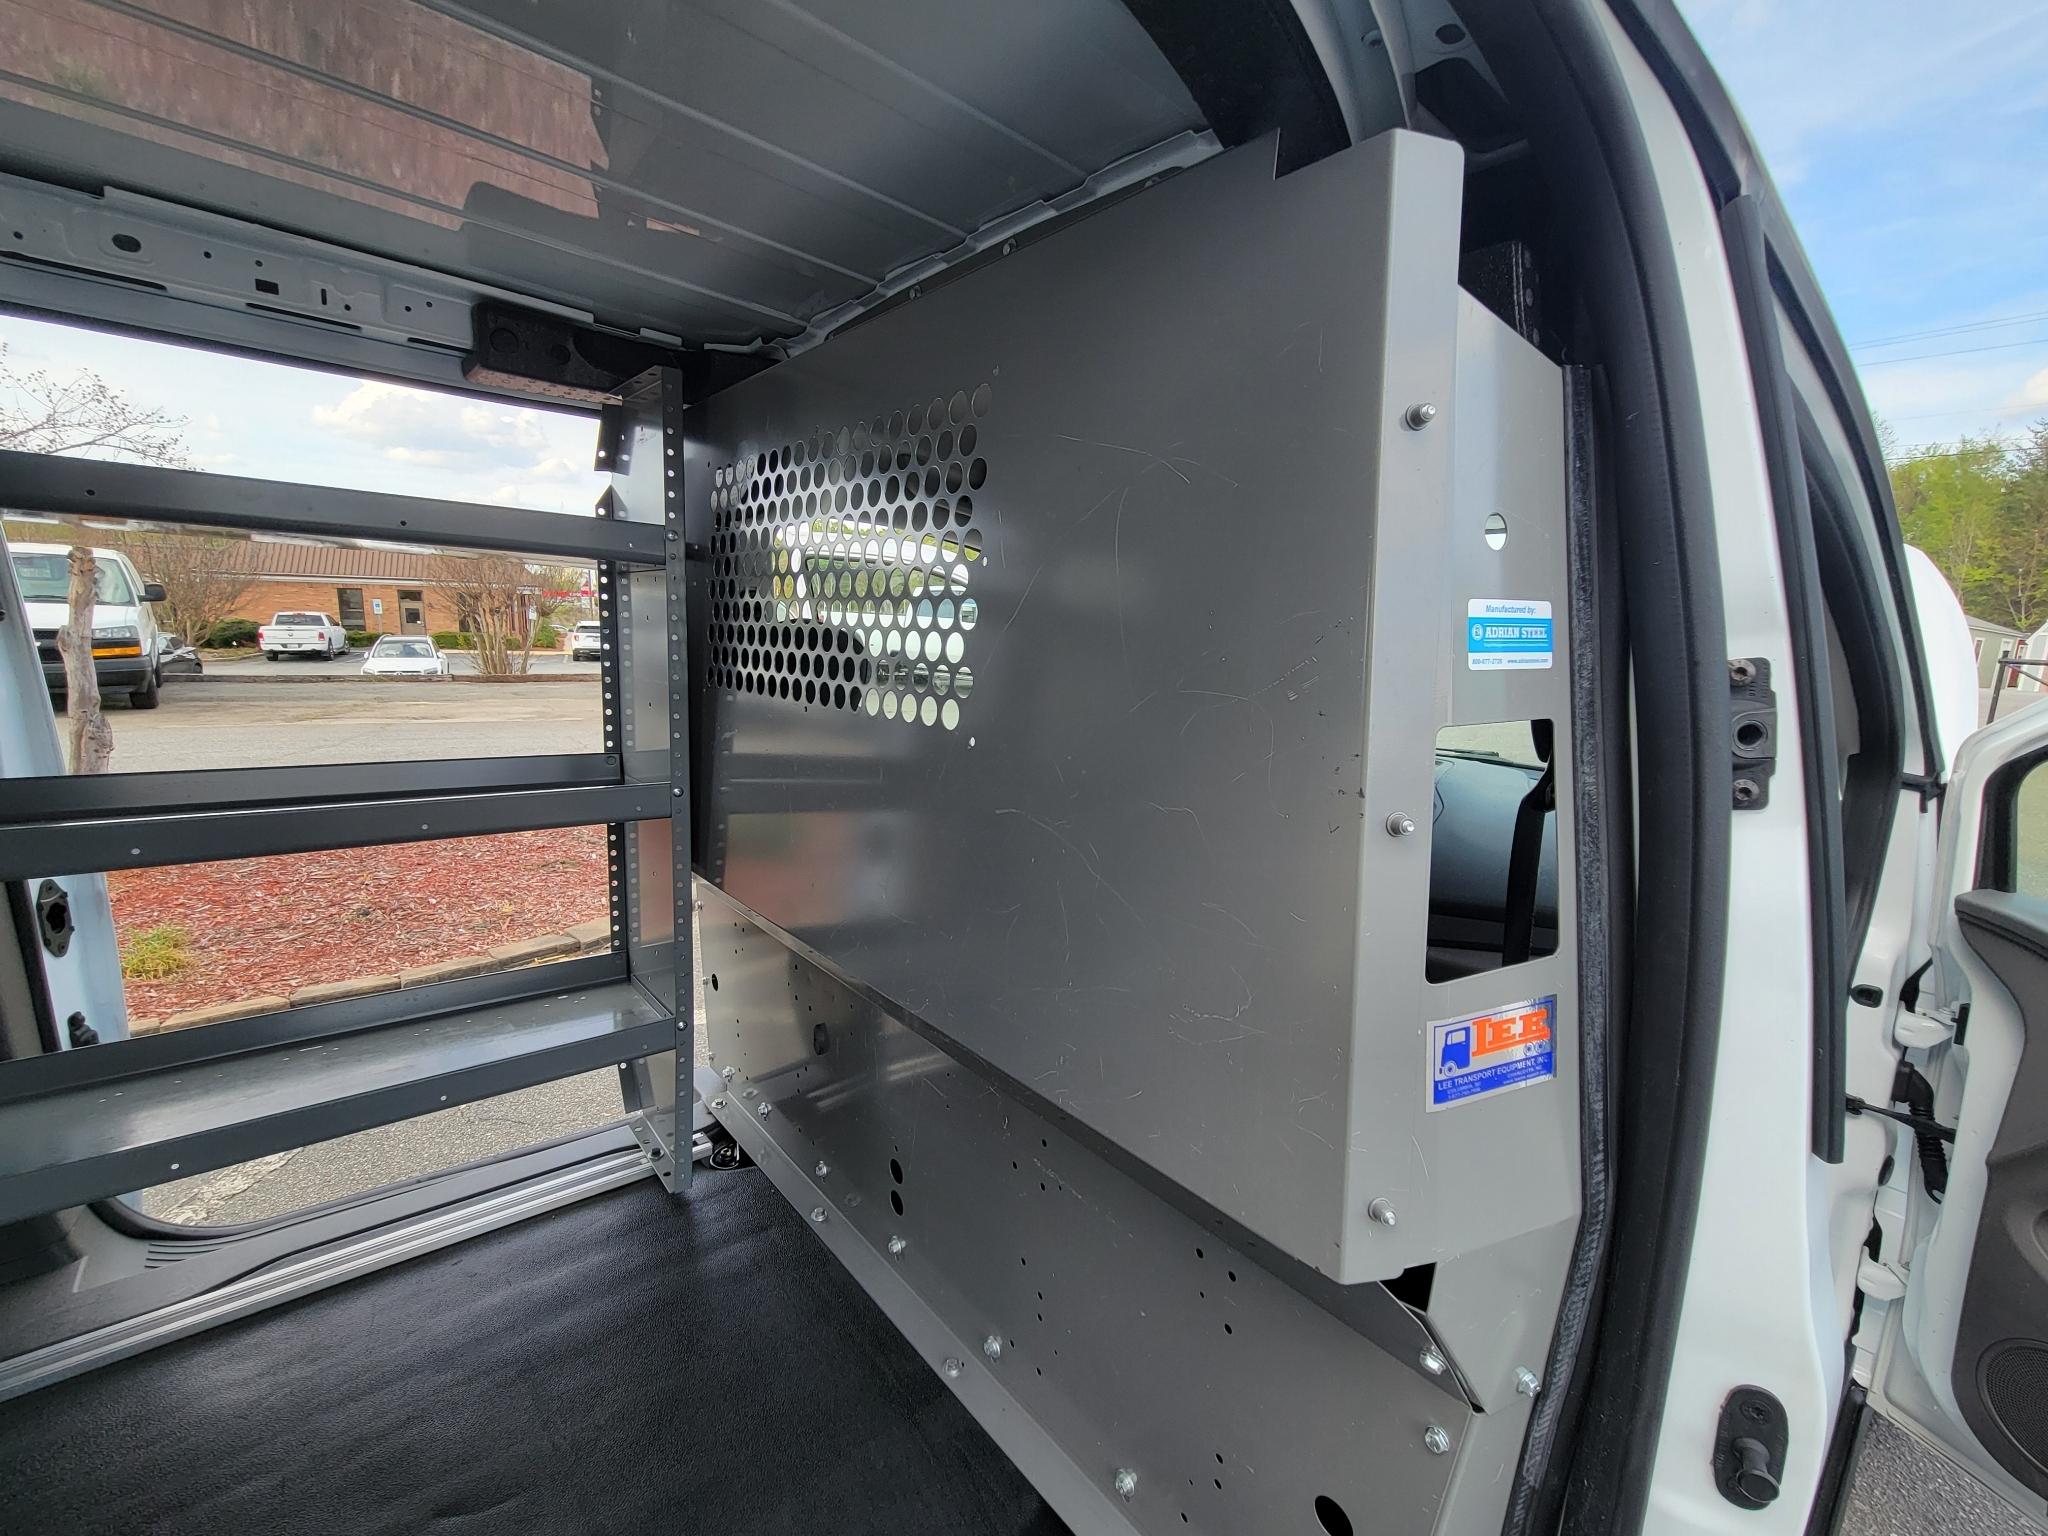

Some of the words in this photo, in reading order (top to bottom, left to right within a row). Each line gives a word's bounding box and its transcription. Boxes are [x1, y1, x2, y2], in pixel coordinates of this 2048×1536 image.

[1485, 604, 1526, 614] Manufactured
[1527, 606, 1537, 616] by:
[1485, 626, 1520, 639] ADRIAN
[1521, 627, 1548, 639] STEEL
[1471, 1007, 1552, 1057] LEE
[1438, 1080, 1453, 1090] LEE
[1455, 1069, 1496, 1086] TRANSPORT
